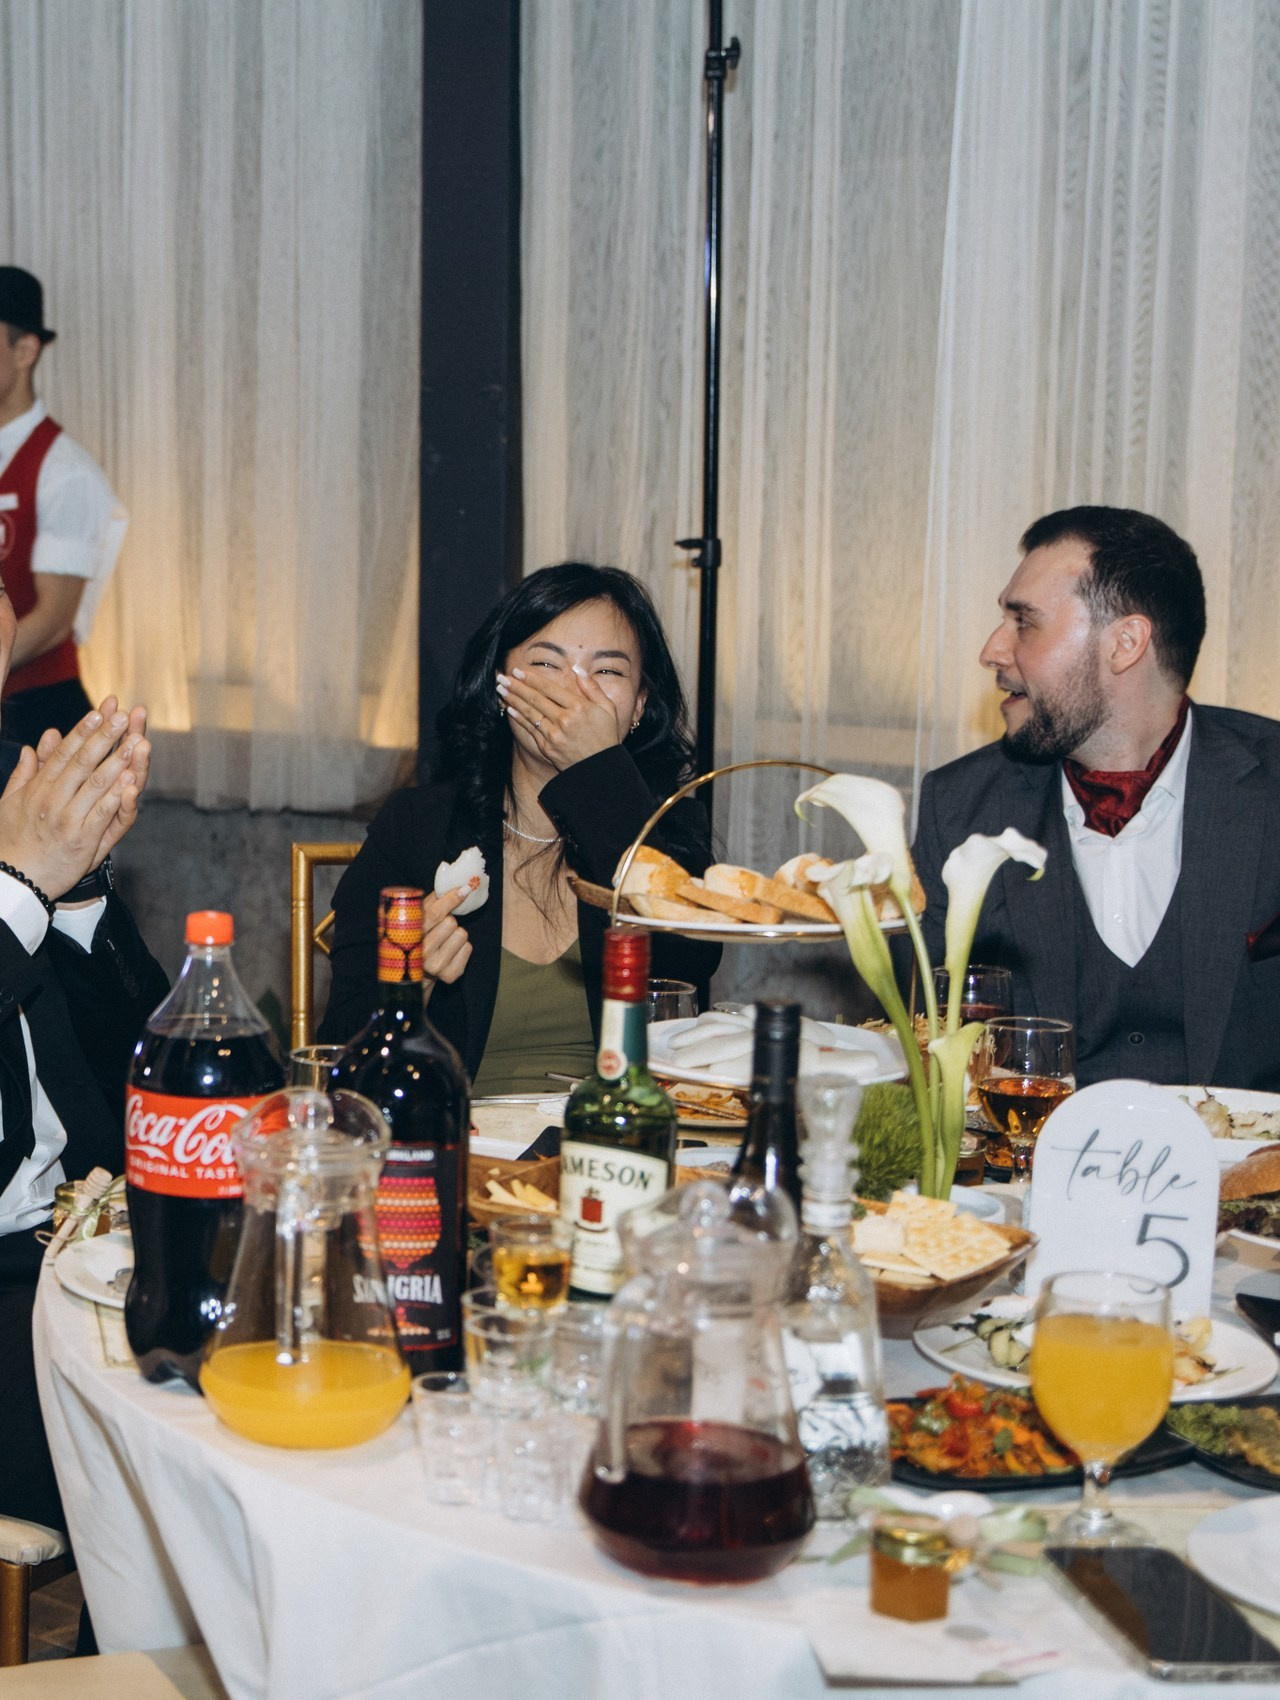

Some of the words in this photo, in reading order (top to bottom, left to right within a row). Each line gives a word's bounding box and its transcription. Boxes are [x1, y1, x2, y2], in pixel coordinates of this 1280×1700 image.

[195, 1166, 237, 1180] TAST
[561, 1154, 654, 1190] AMESON
[1051, 1129, 1197, 1203] table
[1128, 1213, 1190, 1294] 5
